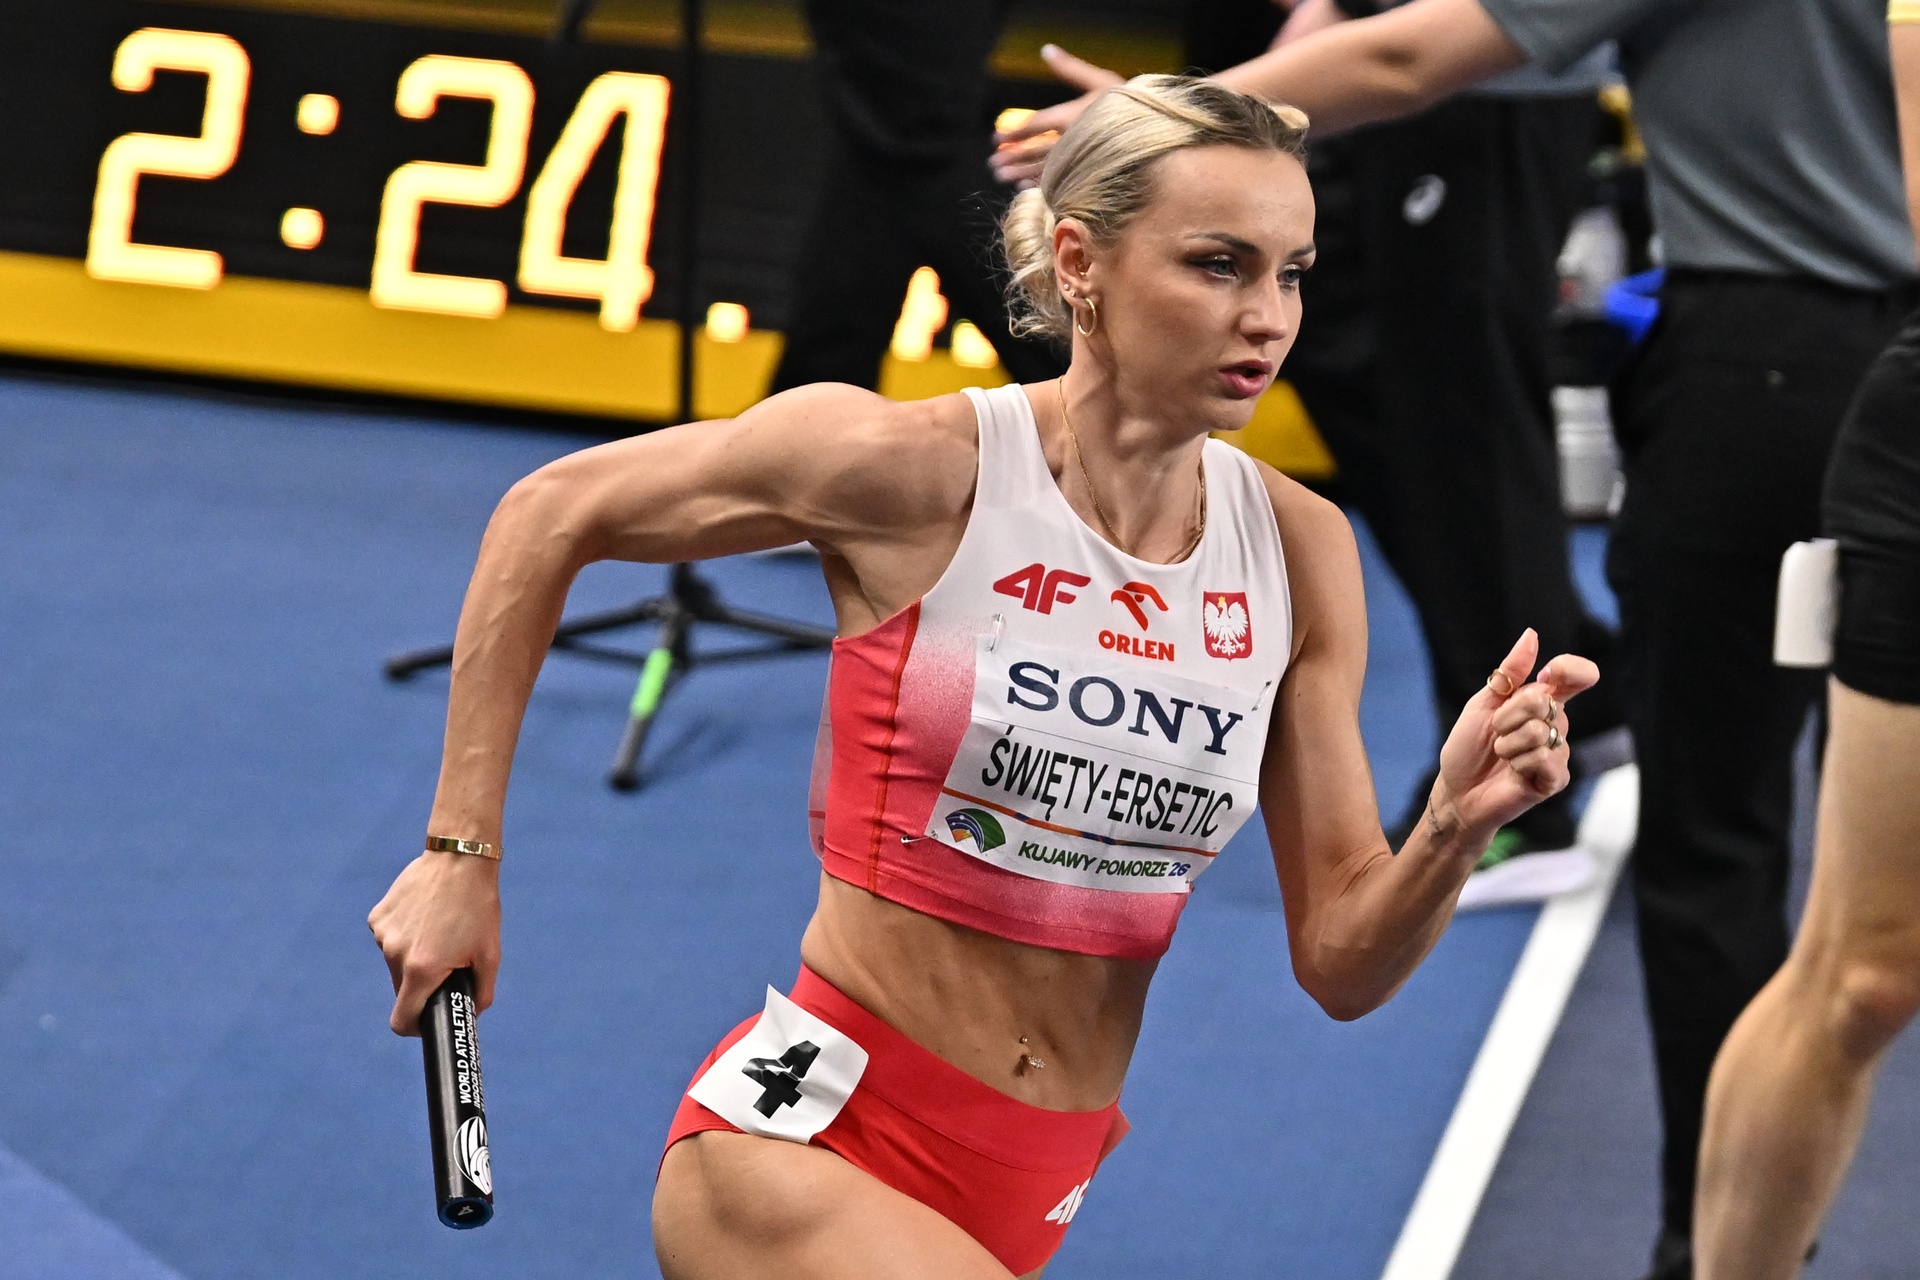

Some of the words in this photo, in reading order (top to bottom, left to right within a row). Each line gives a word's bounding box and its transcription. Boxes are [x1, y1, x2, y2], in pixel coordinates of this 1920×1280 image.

[993, 563, 1091, 615] 4F
[1098, 630, 1175, 662] ORLEN
[1007, 661, 1244, 756] SONY
[981, 724, 1233, 838] ŚWIĘTY-ERSETIC
[1018, 841, 1097, 871] KUJAWY
[1095, 860, 1169, 877] POMORZE
[1168, 862, 1191, 877] 26
[450, 991, 468, 1059] ATHLETICS
[463, 994, 477, 1071] CHAMPIONSHIPS
[457, 1059, 472, 1104] WORLD
[471, 1071, 481, 1109] INDOOR
[741, 1040, 821, 1119] 4
